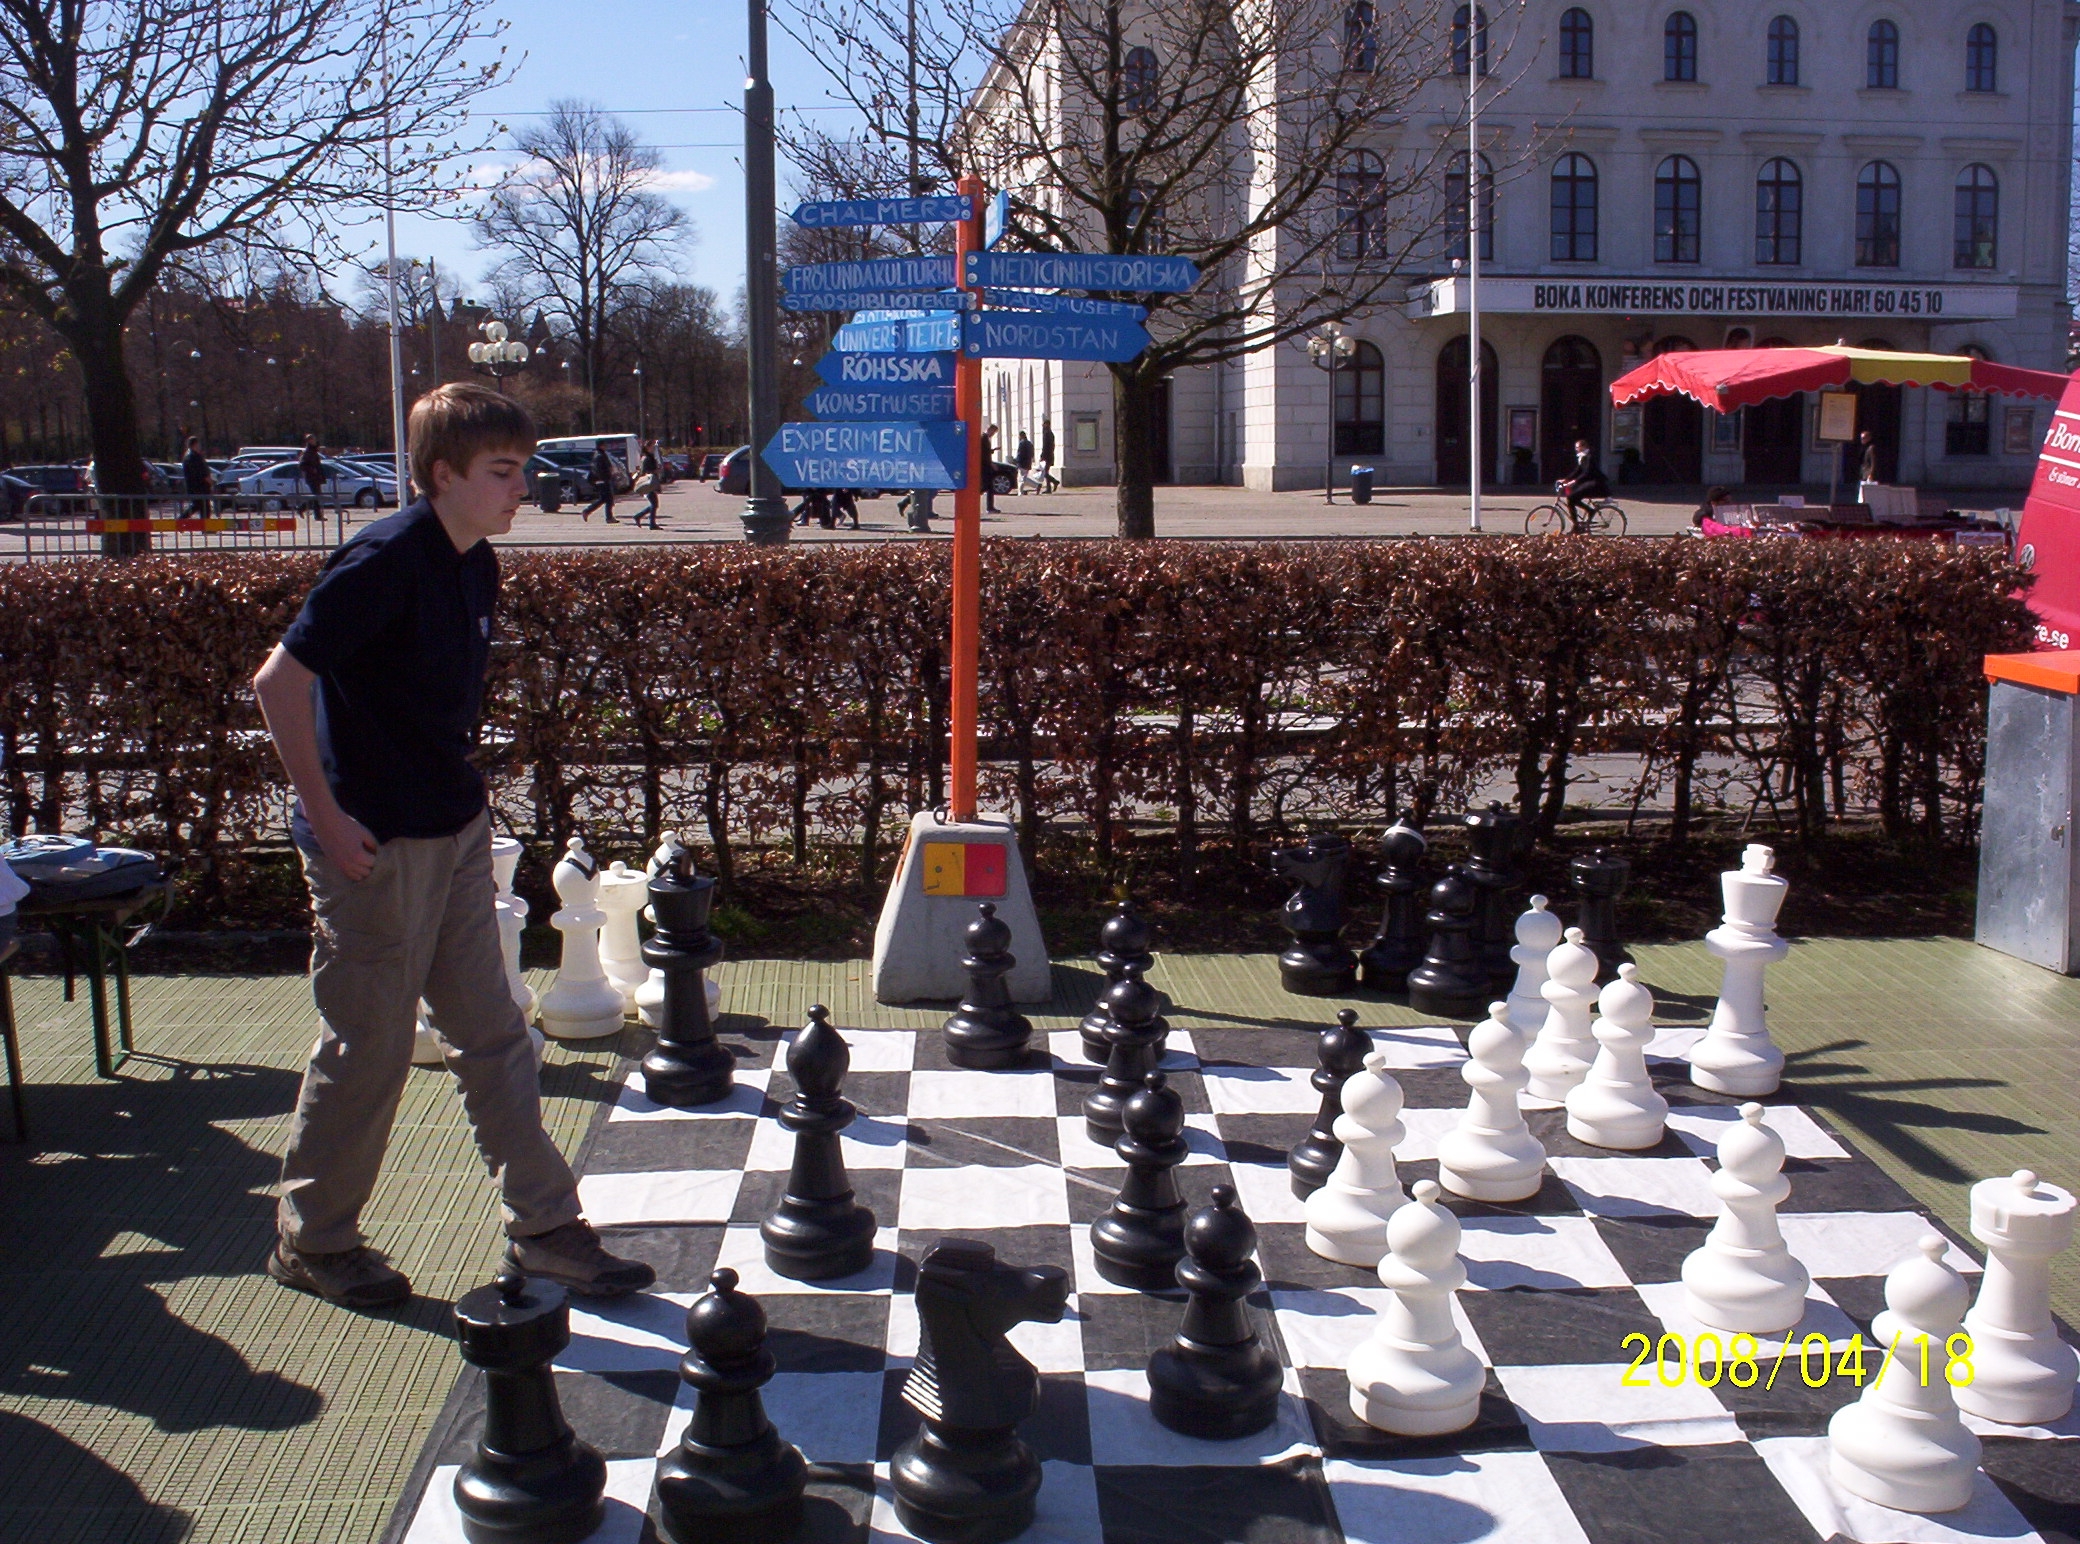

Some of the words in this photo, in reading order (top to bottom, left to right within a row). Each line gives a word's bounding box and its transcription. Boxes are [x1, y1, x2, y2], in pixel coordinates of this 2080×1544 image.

[801, 199, 961, 225] CHALMERS
[990, 257, 1191, 288] MEDICINHISTORISKA
[784, 293, 967, 310] STADSBIBLIOTEKET
[1534, 284, 1581, 309] BOKA
[1585, 285, 1685, 310] KONFERENS
[1688, 287, 1724, 310] OCH
[1873, 290, 1895, 313] 60
[1899, 290, 1921, 313] 45
[1924, 291, 1943, 313] 10
[839, 320, 953, 352] UNIVERSITETET
[986, 322, 1118, 350] NORDSTAN
[842, 352, 942, 382] RÖHSSKA
[816, 393, 956, 415] KONSTMUSEET
[782, 427, 928, 453] EXPERIMENT
[795, 458, 924, 484] VERKSTADEN
